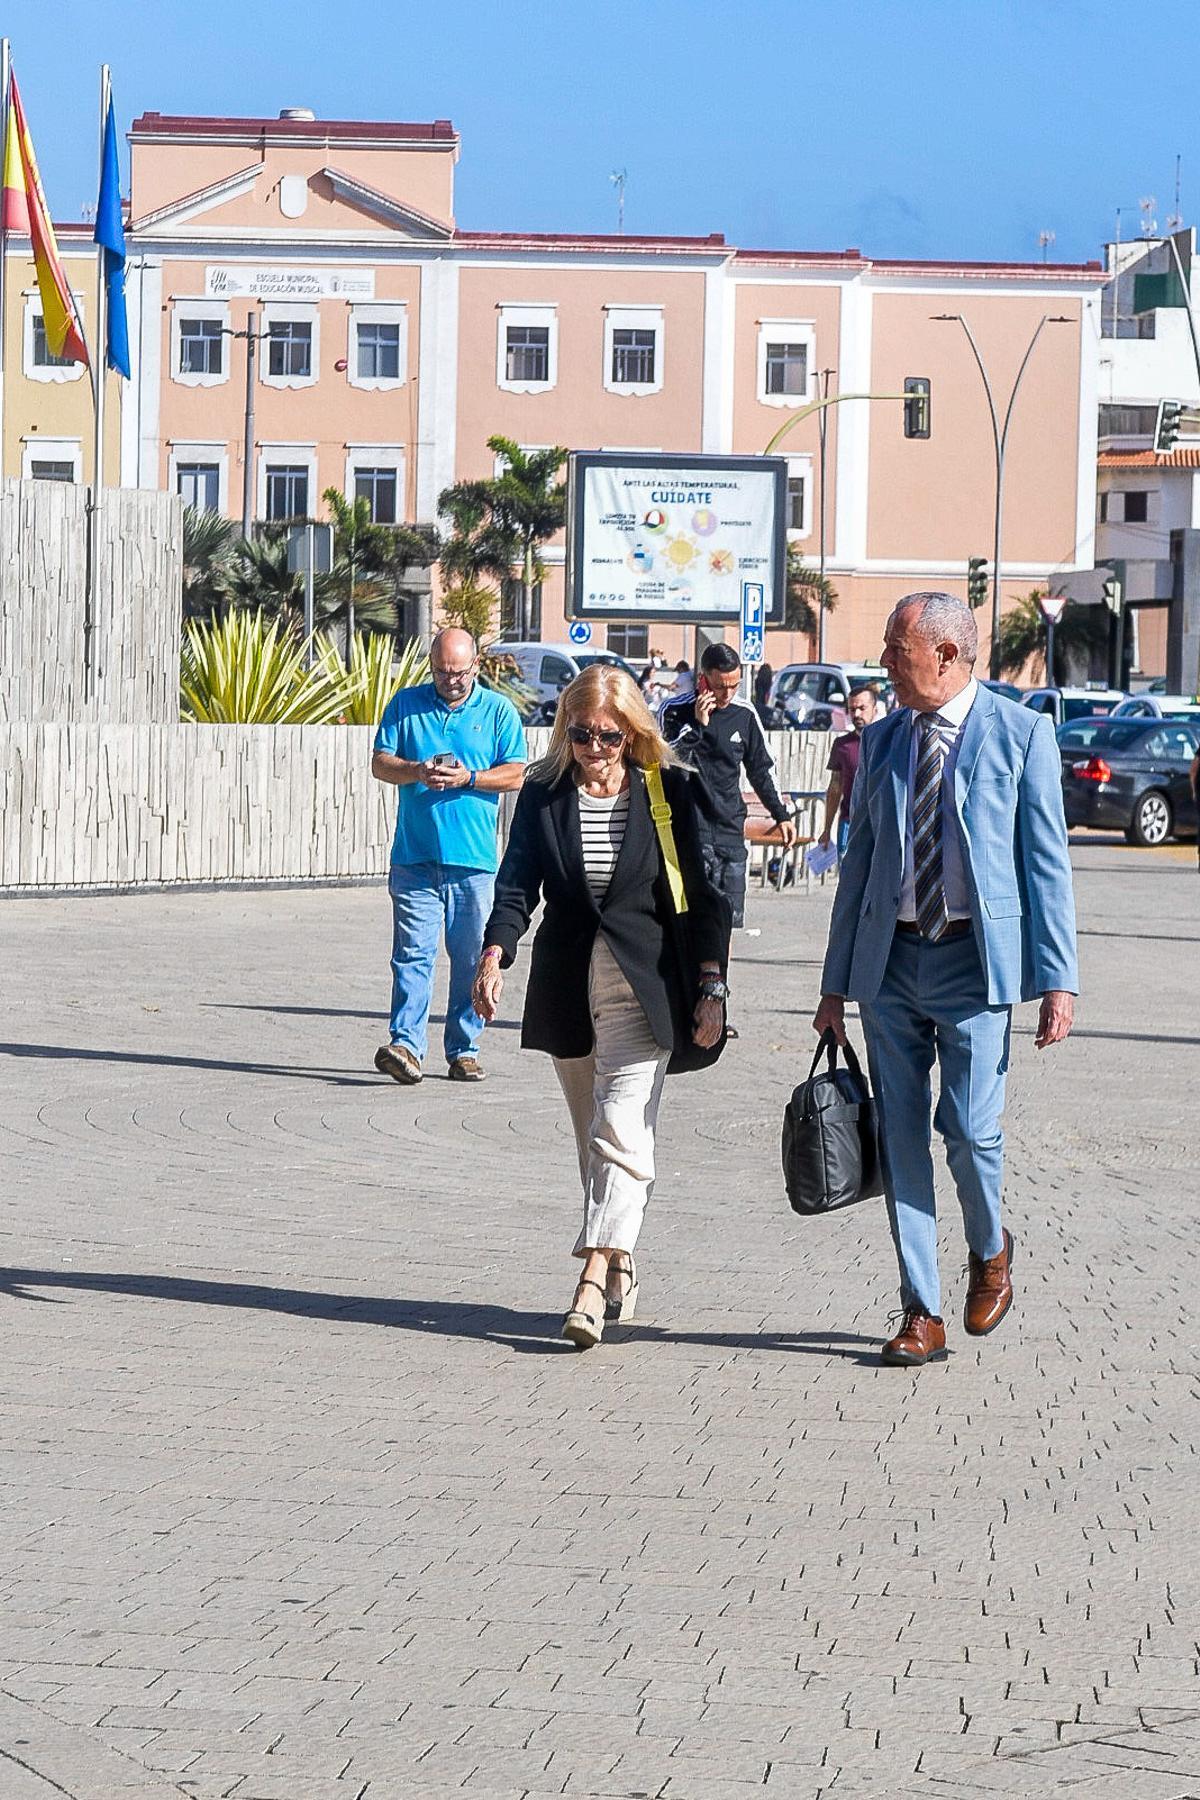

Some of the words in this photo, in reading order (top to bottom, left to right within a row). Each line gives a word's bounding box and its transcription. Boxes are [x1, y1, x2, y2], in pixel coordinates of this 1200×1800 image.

[256, 273, 284, 283] ESCUELA
[287, 274, 320, 284] MUNICIPAL
[298, 284, 325, 294] MUSICAL
[658, 480, 679, 488] ALTAS
[747, 588, 761, 622] P
